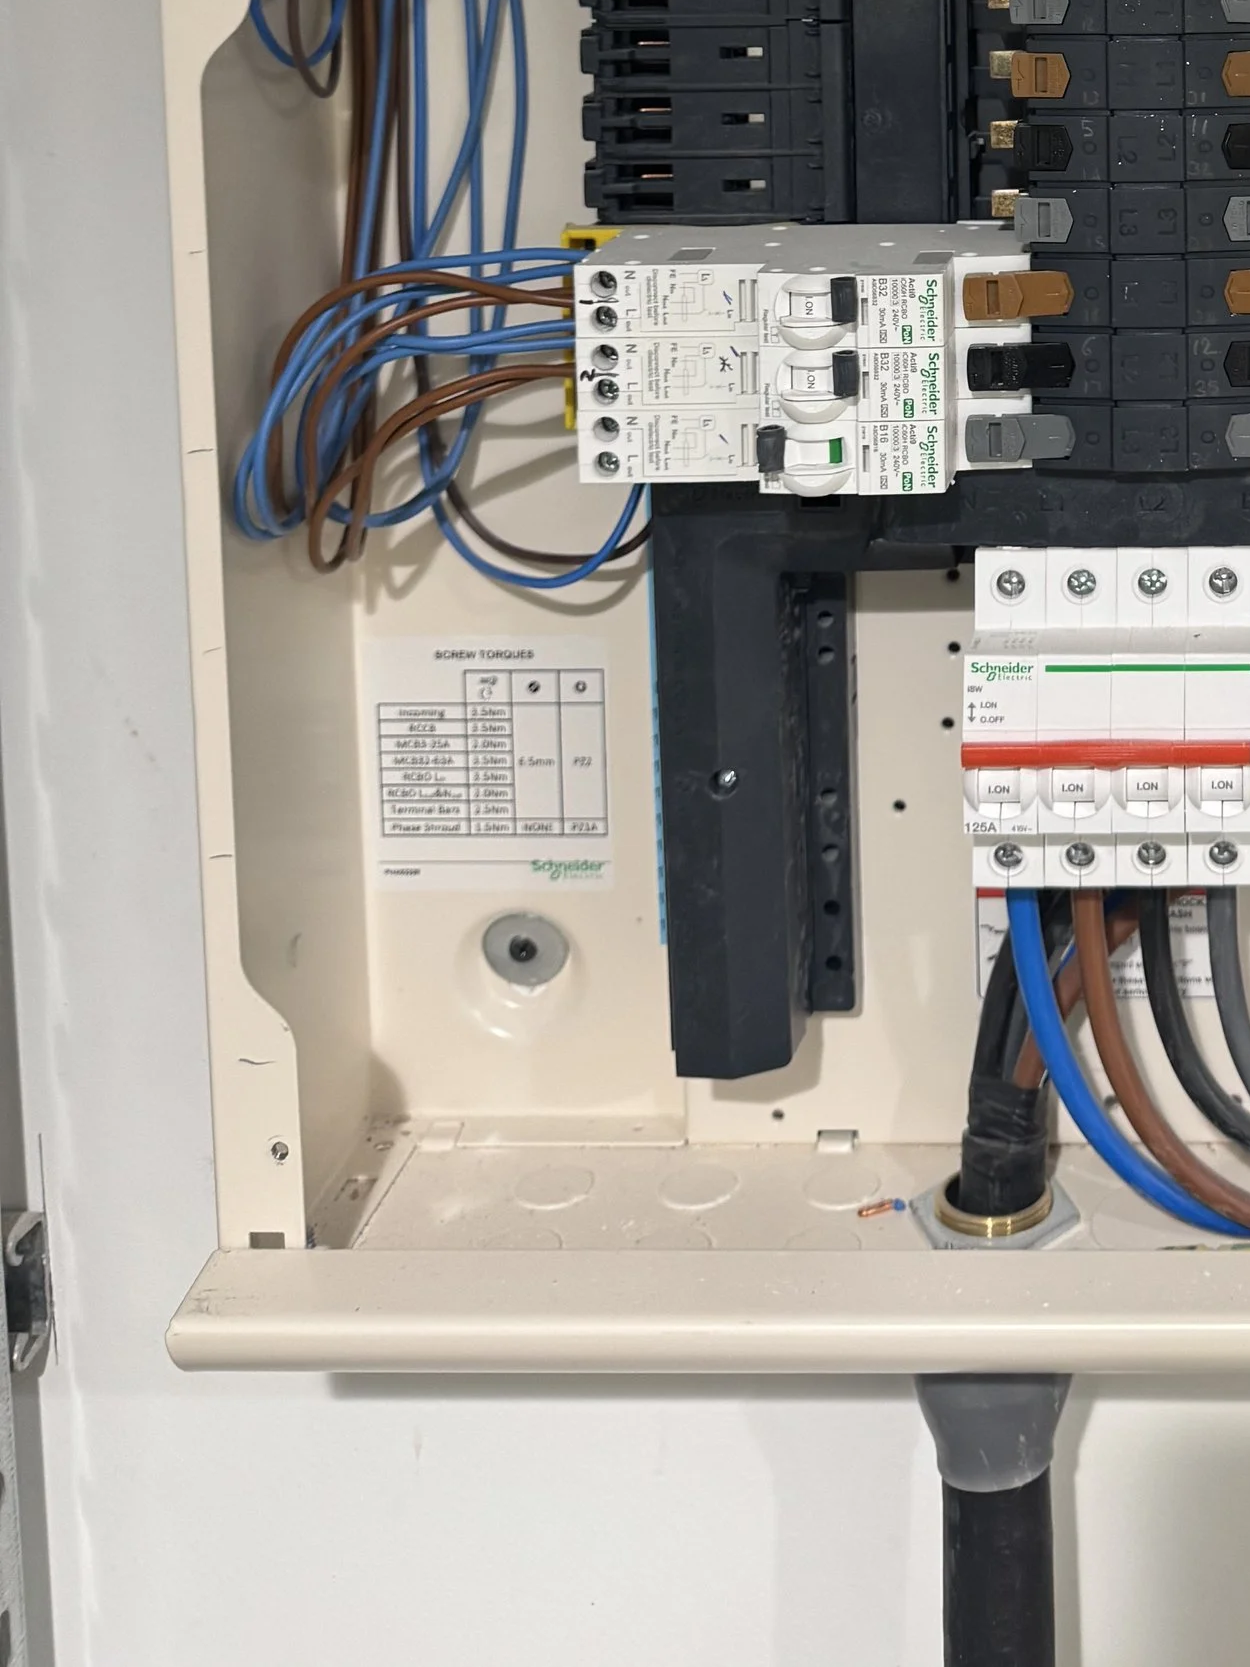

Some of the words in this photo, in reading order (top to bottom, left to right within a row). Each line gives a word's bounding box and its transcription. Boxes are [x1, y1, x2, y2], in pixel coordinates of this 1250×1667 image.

[878, 278, 887, 297] B32
[926, 279, 937, 342] Schneider
[879, 353, 888, 372] B32
[929, 353, 939, 415] Schneider
[927, 426, 937, 489] Schneider
[903, 473, 911, 490] PoN
[434, 650, 475, 659] SCREW
[480, 649, 534, 659] TORQUES
[971, 662, 1033, 673] Schneider
[988, 785, 1010, 794] I.ON
[1062, 782, 1083, 793] I.ON
[1136, 781, 1158, 792] I.ON
[1211, 780, 1233, 791] I.ON
[965, 822, 997, 832] 125A
[532, 860, 605, 872] Schneider
